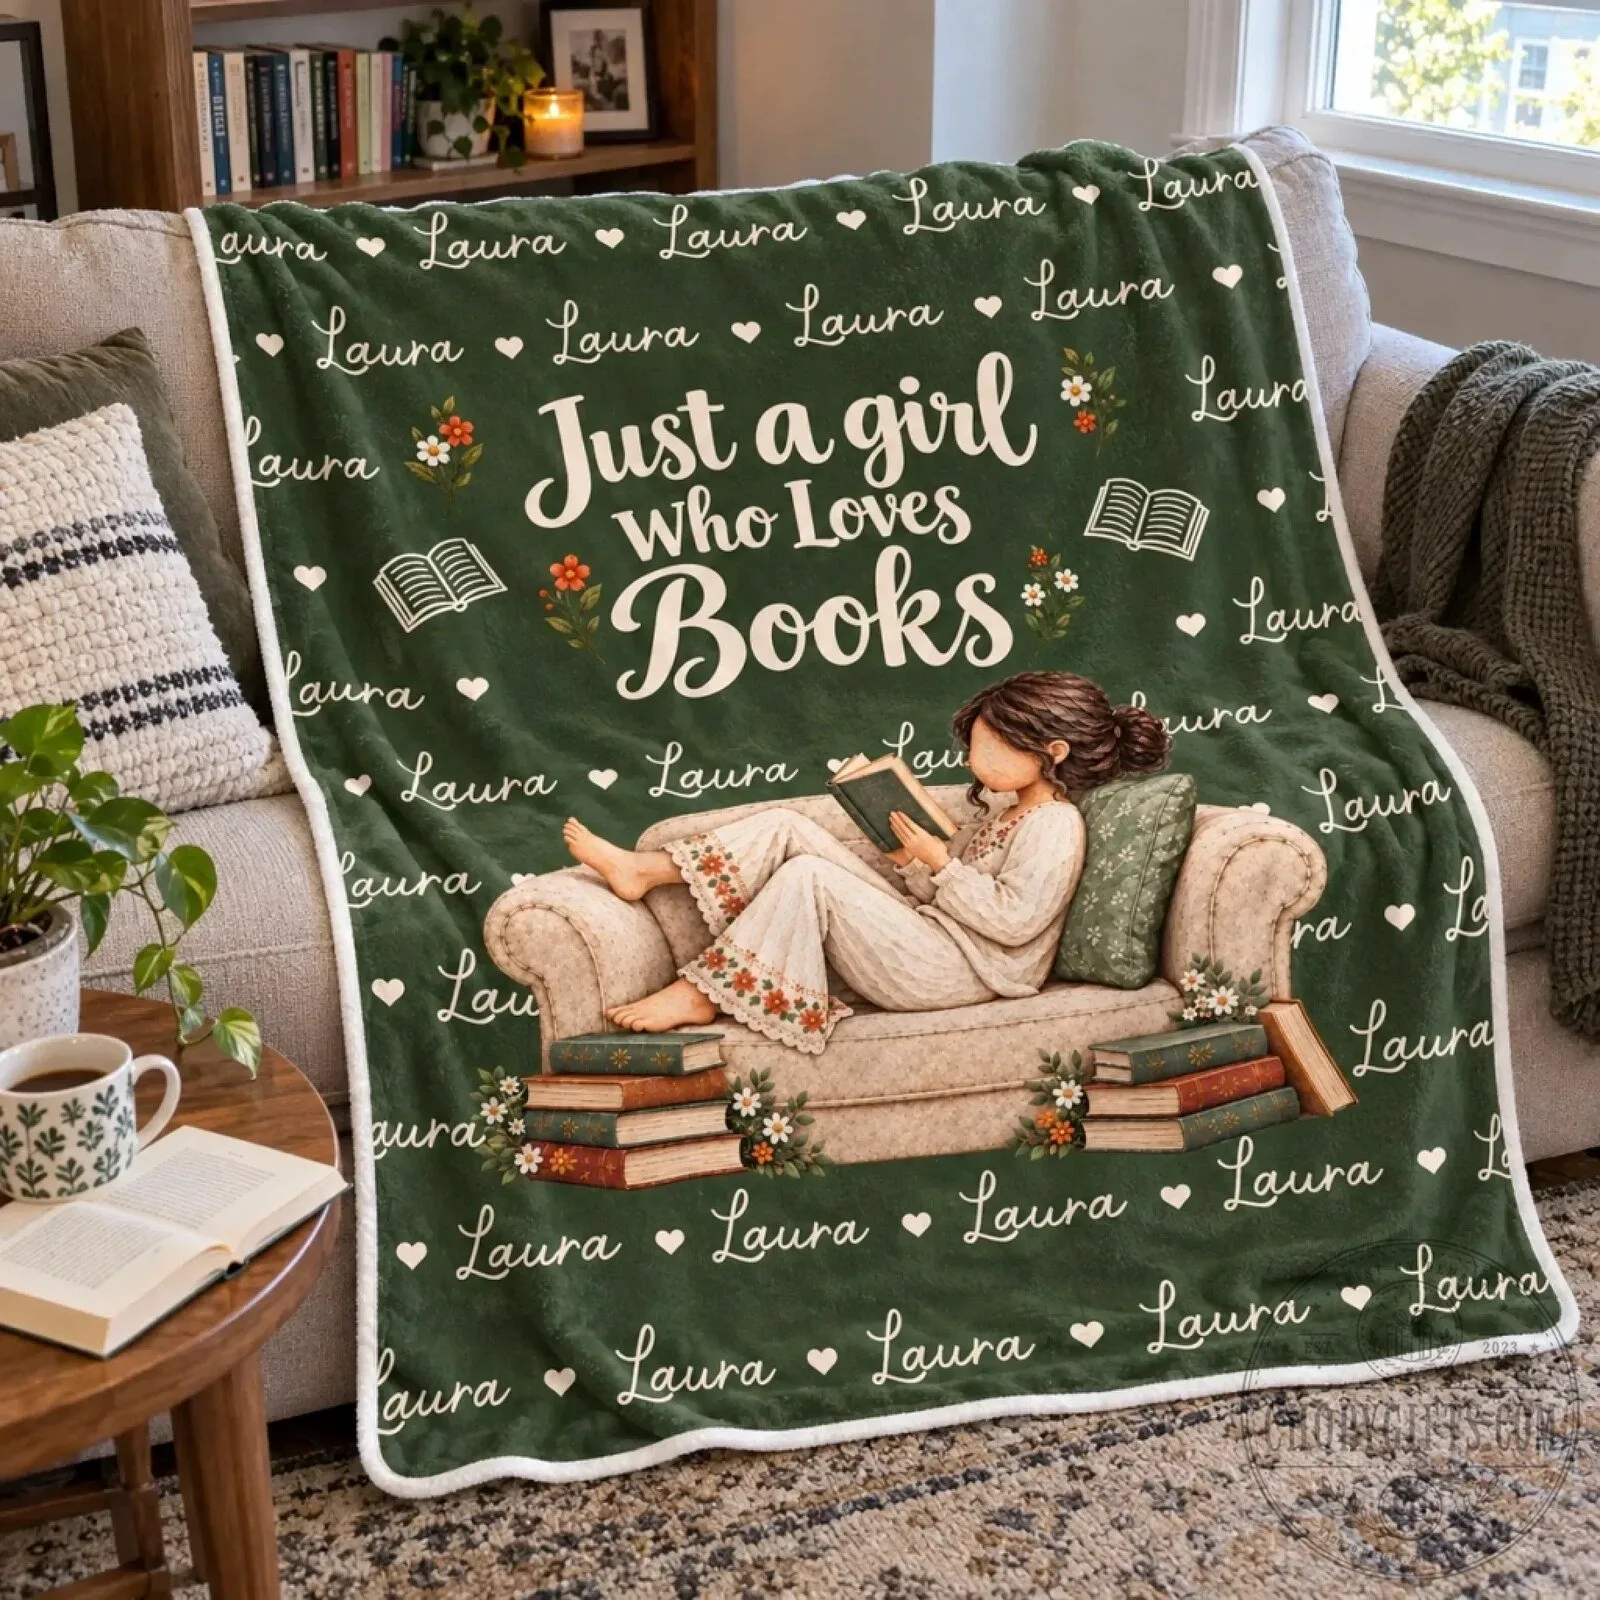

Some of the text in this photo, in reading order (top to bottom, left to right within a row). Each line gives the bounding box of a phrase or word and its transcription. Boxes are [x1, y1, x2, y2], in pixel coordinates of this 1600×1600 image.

[214, 157, 1259, 270] aura Laura Laura Laura Laura
[310, 258, 1176, 376] Laura Laura Laura Laura
[1183, 354, 1310, 422] Laura
[522, 350, 1038, 529] Just a girl
[783, 479, 972, 549] Loves
[610, 544, 1014, 701] Books
[1232, 575, 1364, 645] Laura
[396, 750, 558, 811] Laura
[644, 741, 799, 799] Laura
[881, 720, 970, 779] Lau
[1300, 767, 1452, 834] Laura
[436, 947, 540, 1025] Lau
[1349, 998, 1495, 1077] Laura
[369, 1116, 487, 1161] aura
[455, 1204, 623, 1281] Laura
[710, 1188, 870, 1264] Laura
[958, 1169, 1129, 1245] Laura
[1216, 1135, 1384, 1212] Laura
[614, 1323, 777, 1406] Laura
[866, 1308, 1036, 1386] Laura
[1138, 1279, 1311, 1355] Laura
[1399, 1243, 1549, 1317] Laura
